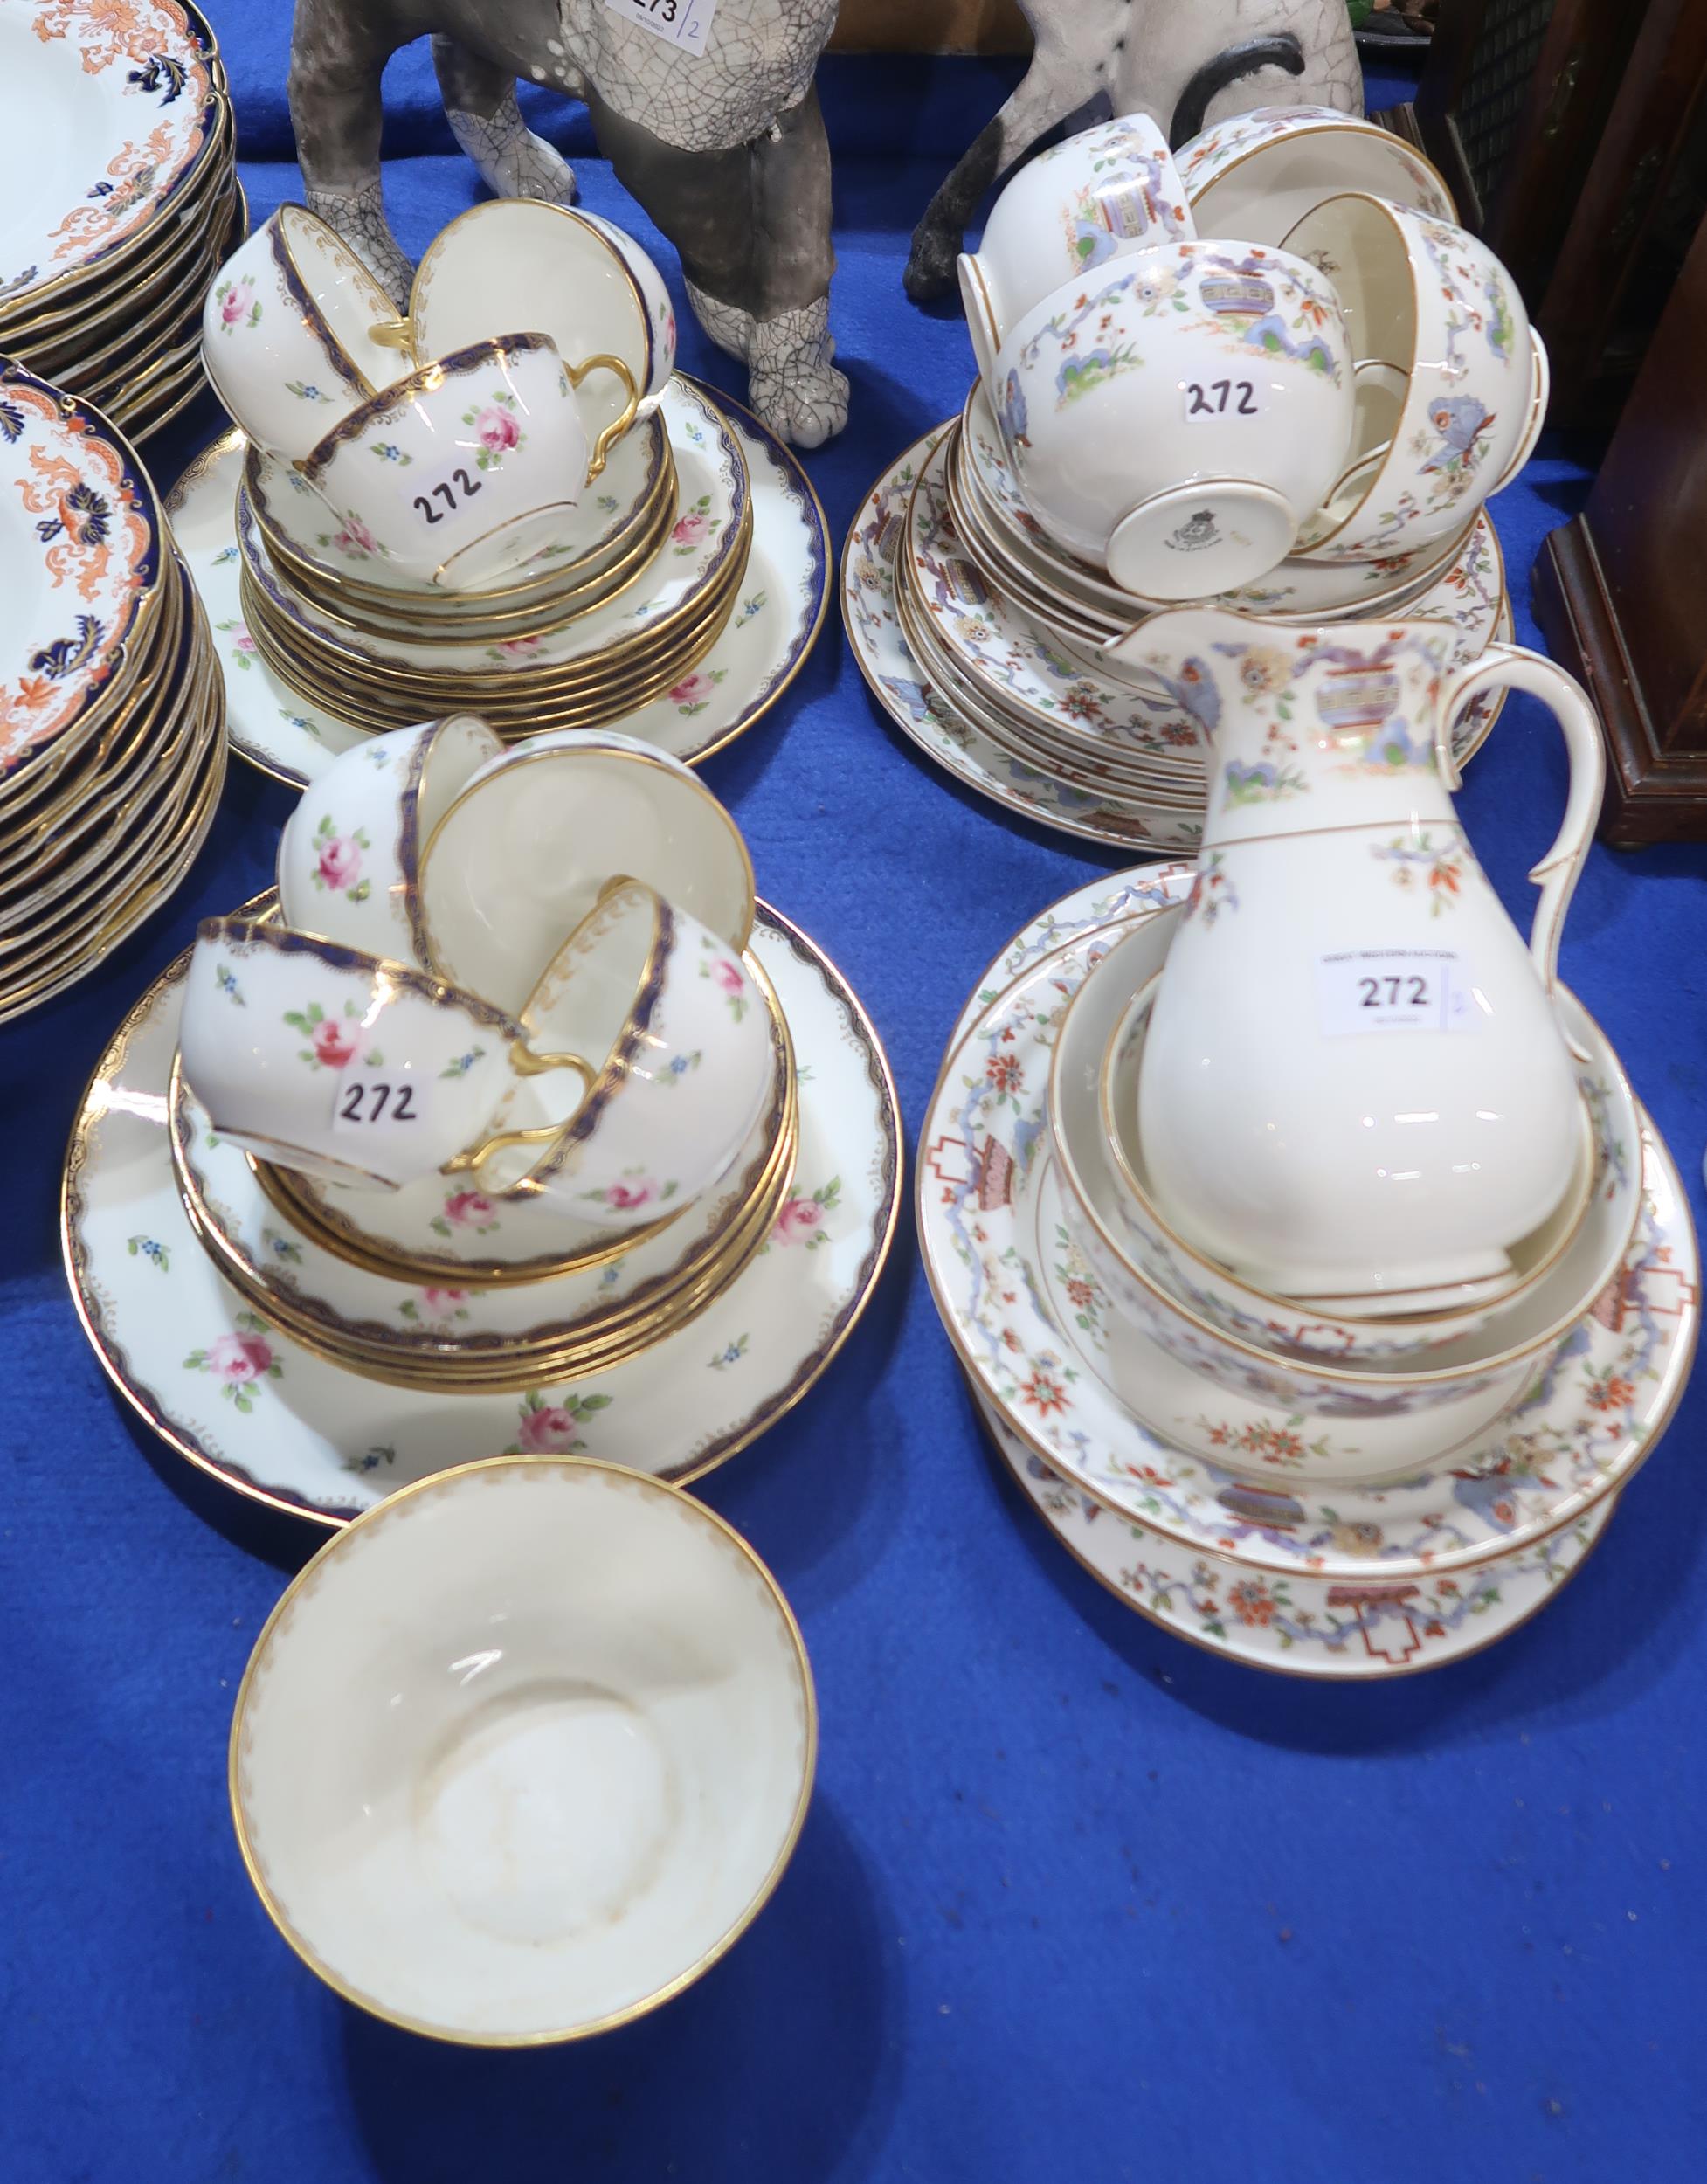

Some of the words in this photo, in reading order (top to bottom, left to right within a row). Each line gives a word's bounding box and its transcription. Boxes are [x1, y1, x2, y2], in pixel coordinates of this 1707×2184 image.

[688, 20, 700, 38] 2
[1188, 379, 1258, 415] 272
[413, 468, 482, 523] 272
[1358, 975, 1430, 1006] 272
[340, 1082, 417, 1122] 272
